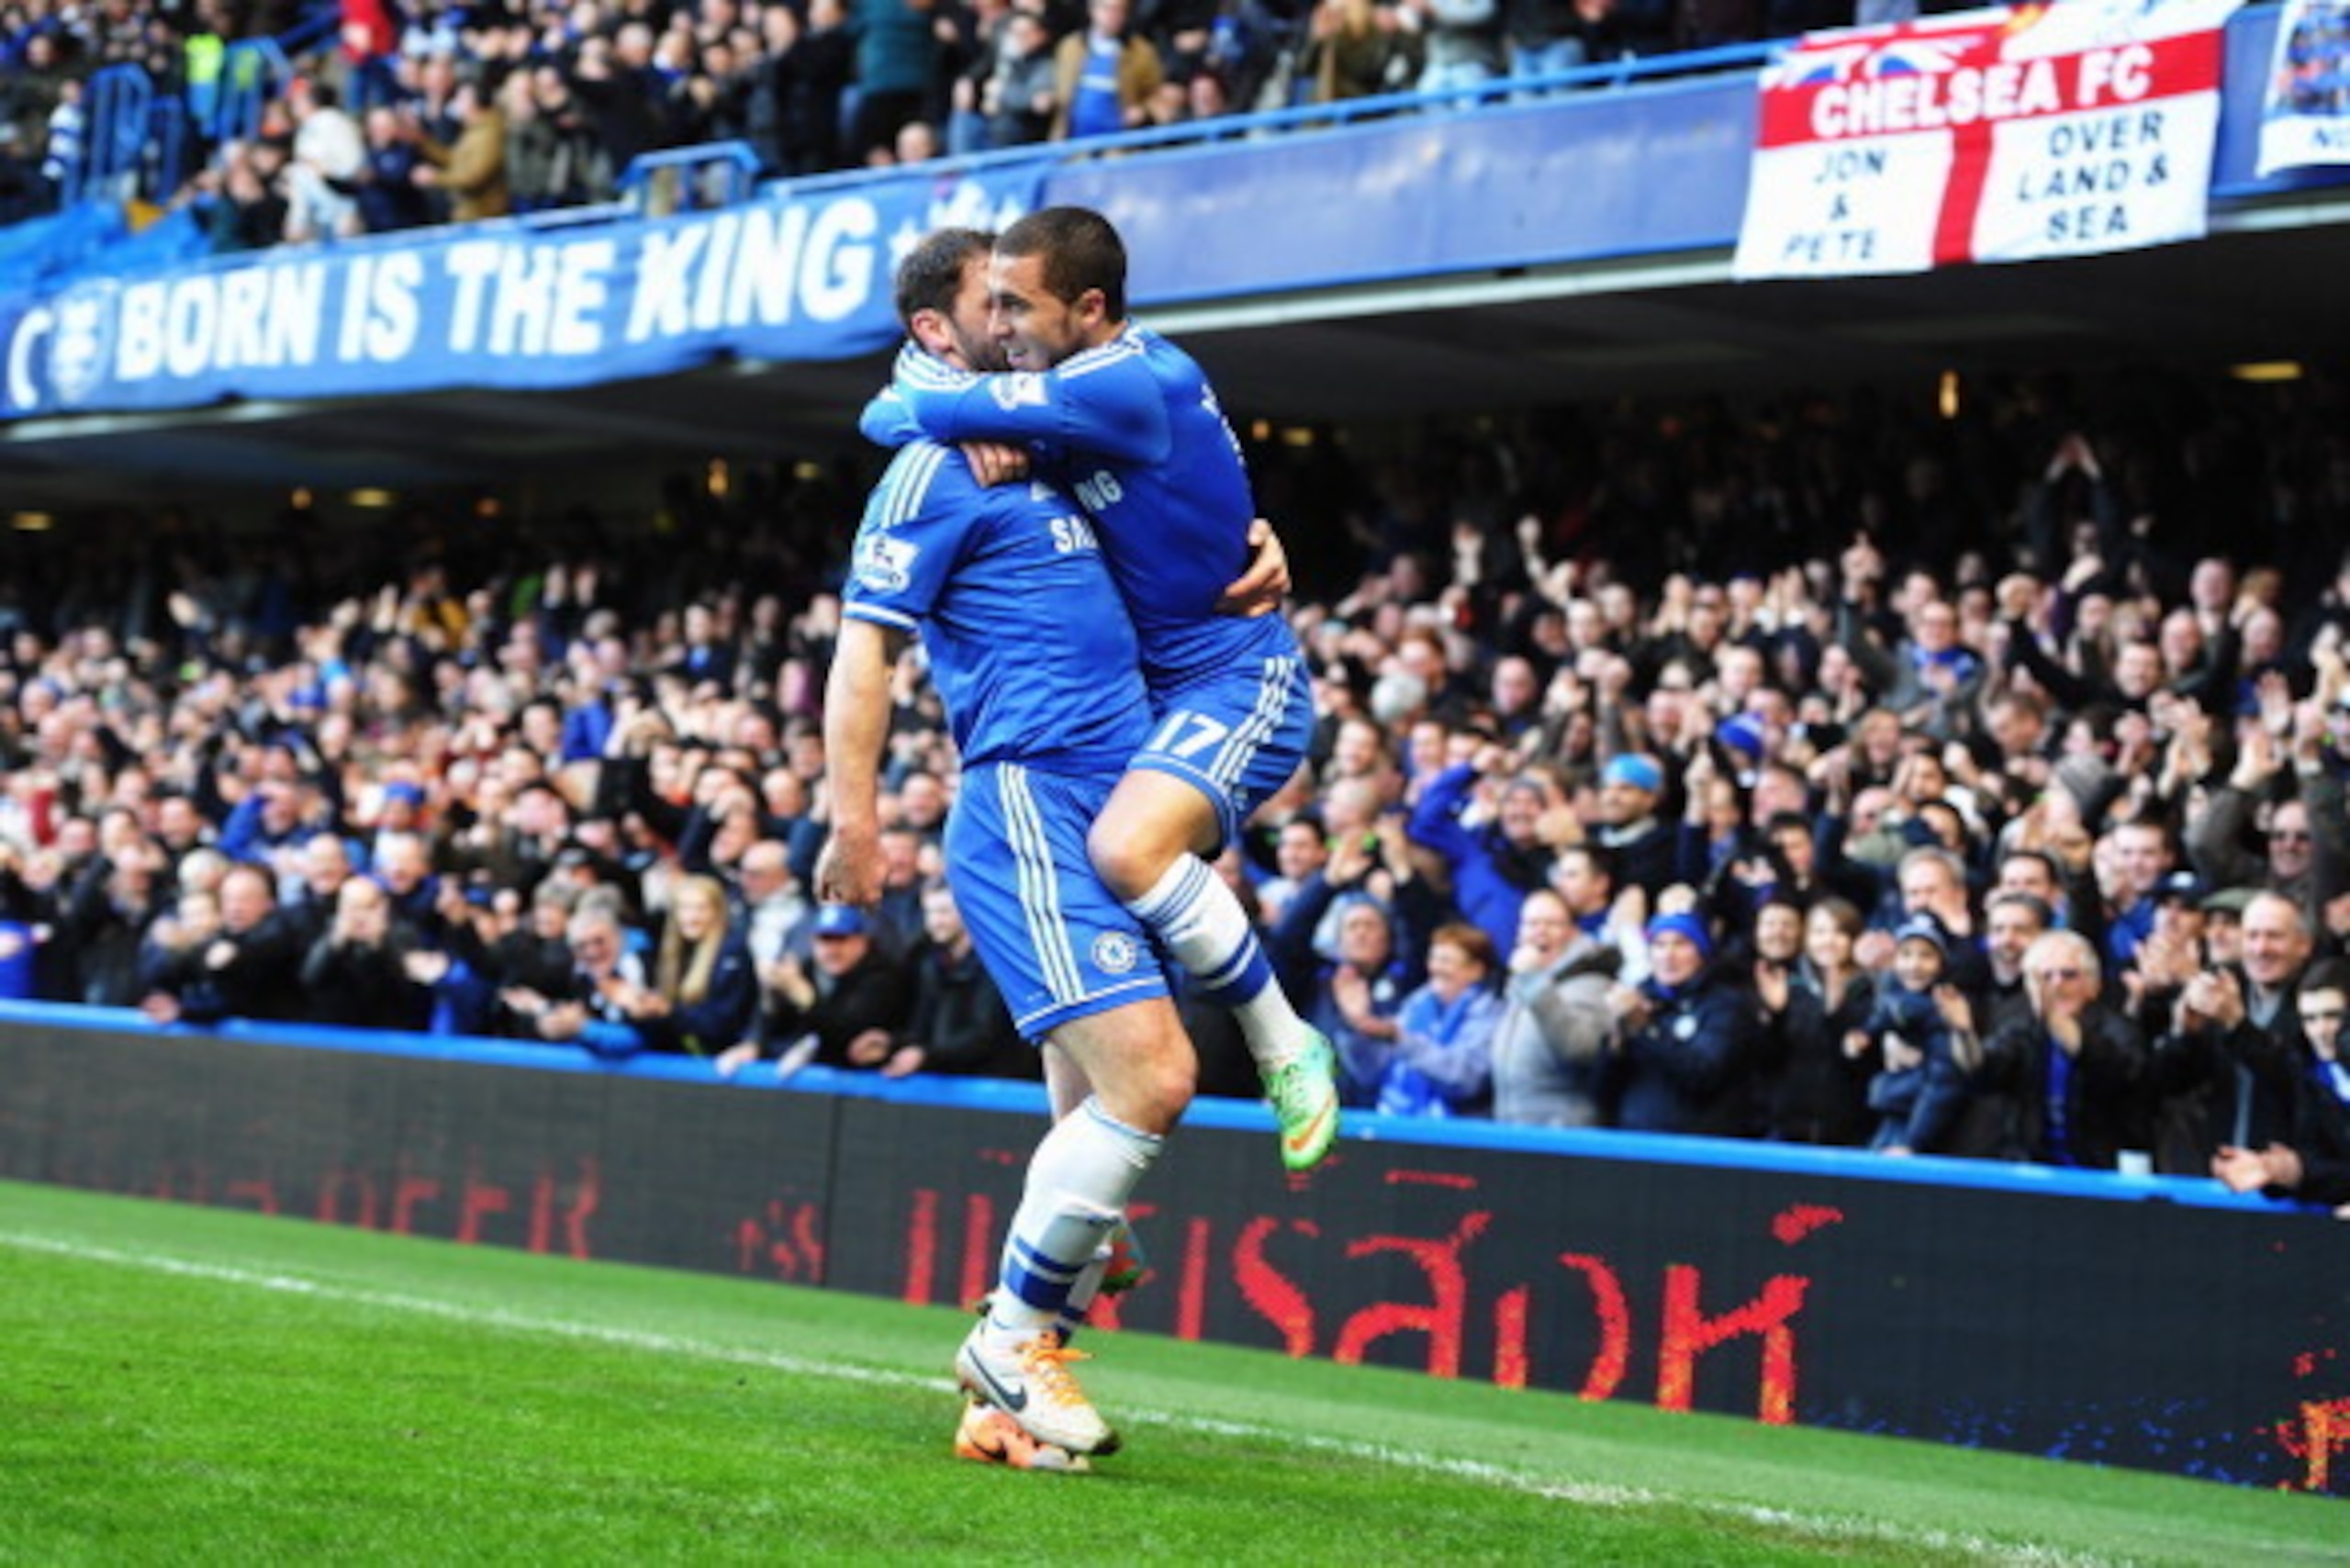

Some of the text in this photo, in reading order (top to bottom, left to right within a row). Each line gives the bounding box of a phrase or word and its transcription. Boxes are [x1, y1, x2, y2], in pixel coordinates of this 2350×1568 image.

[1811, 43, 2154, 138] CHELSEA FC
[2047, 111, 2165, 157] OVER
[1815, 150, 1886, 183] JON
[2018, 153, 2170, 202] LAND &
[1783, 229, 1876, 263] PETE
[2047, 204, 2129, 241] SEA
[116, 260, 324, 380] BORN
[339, 252, 421, 363] IS
[446, 240, 615, 355] THE
[627, 198, 878, 343] KING
[1146, 710, 1229, 758] 17
